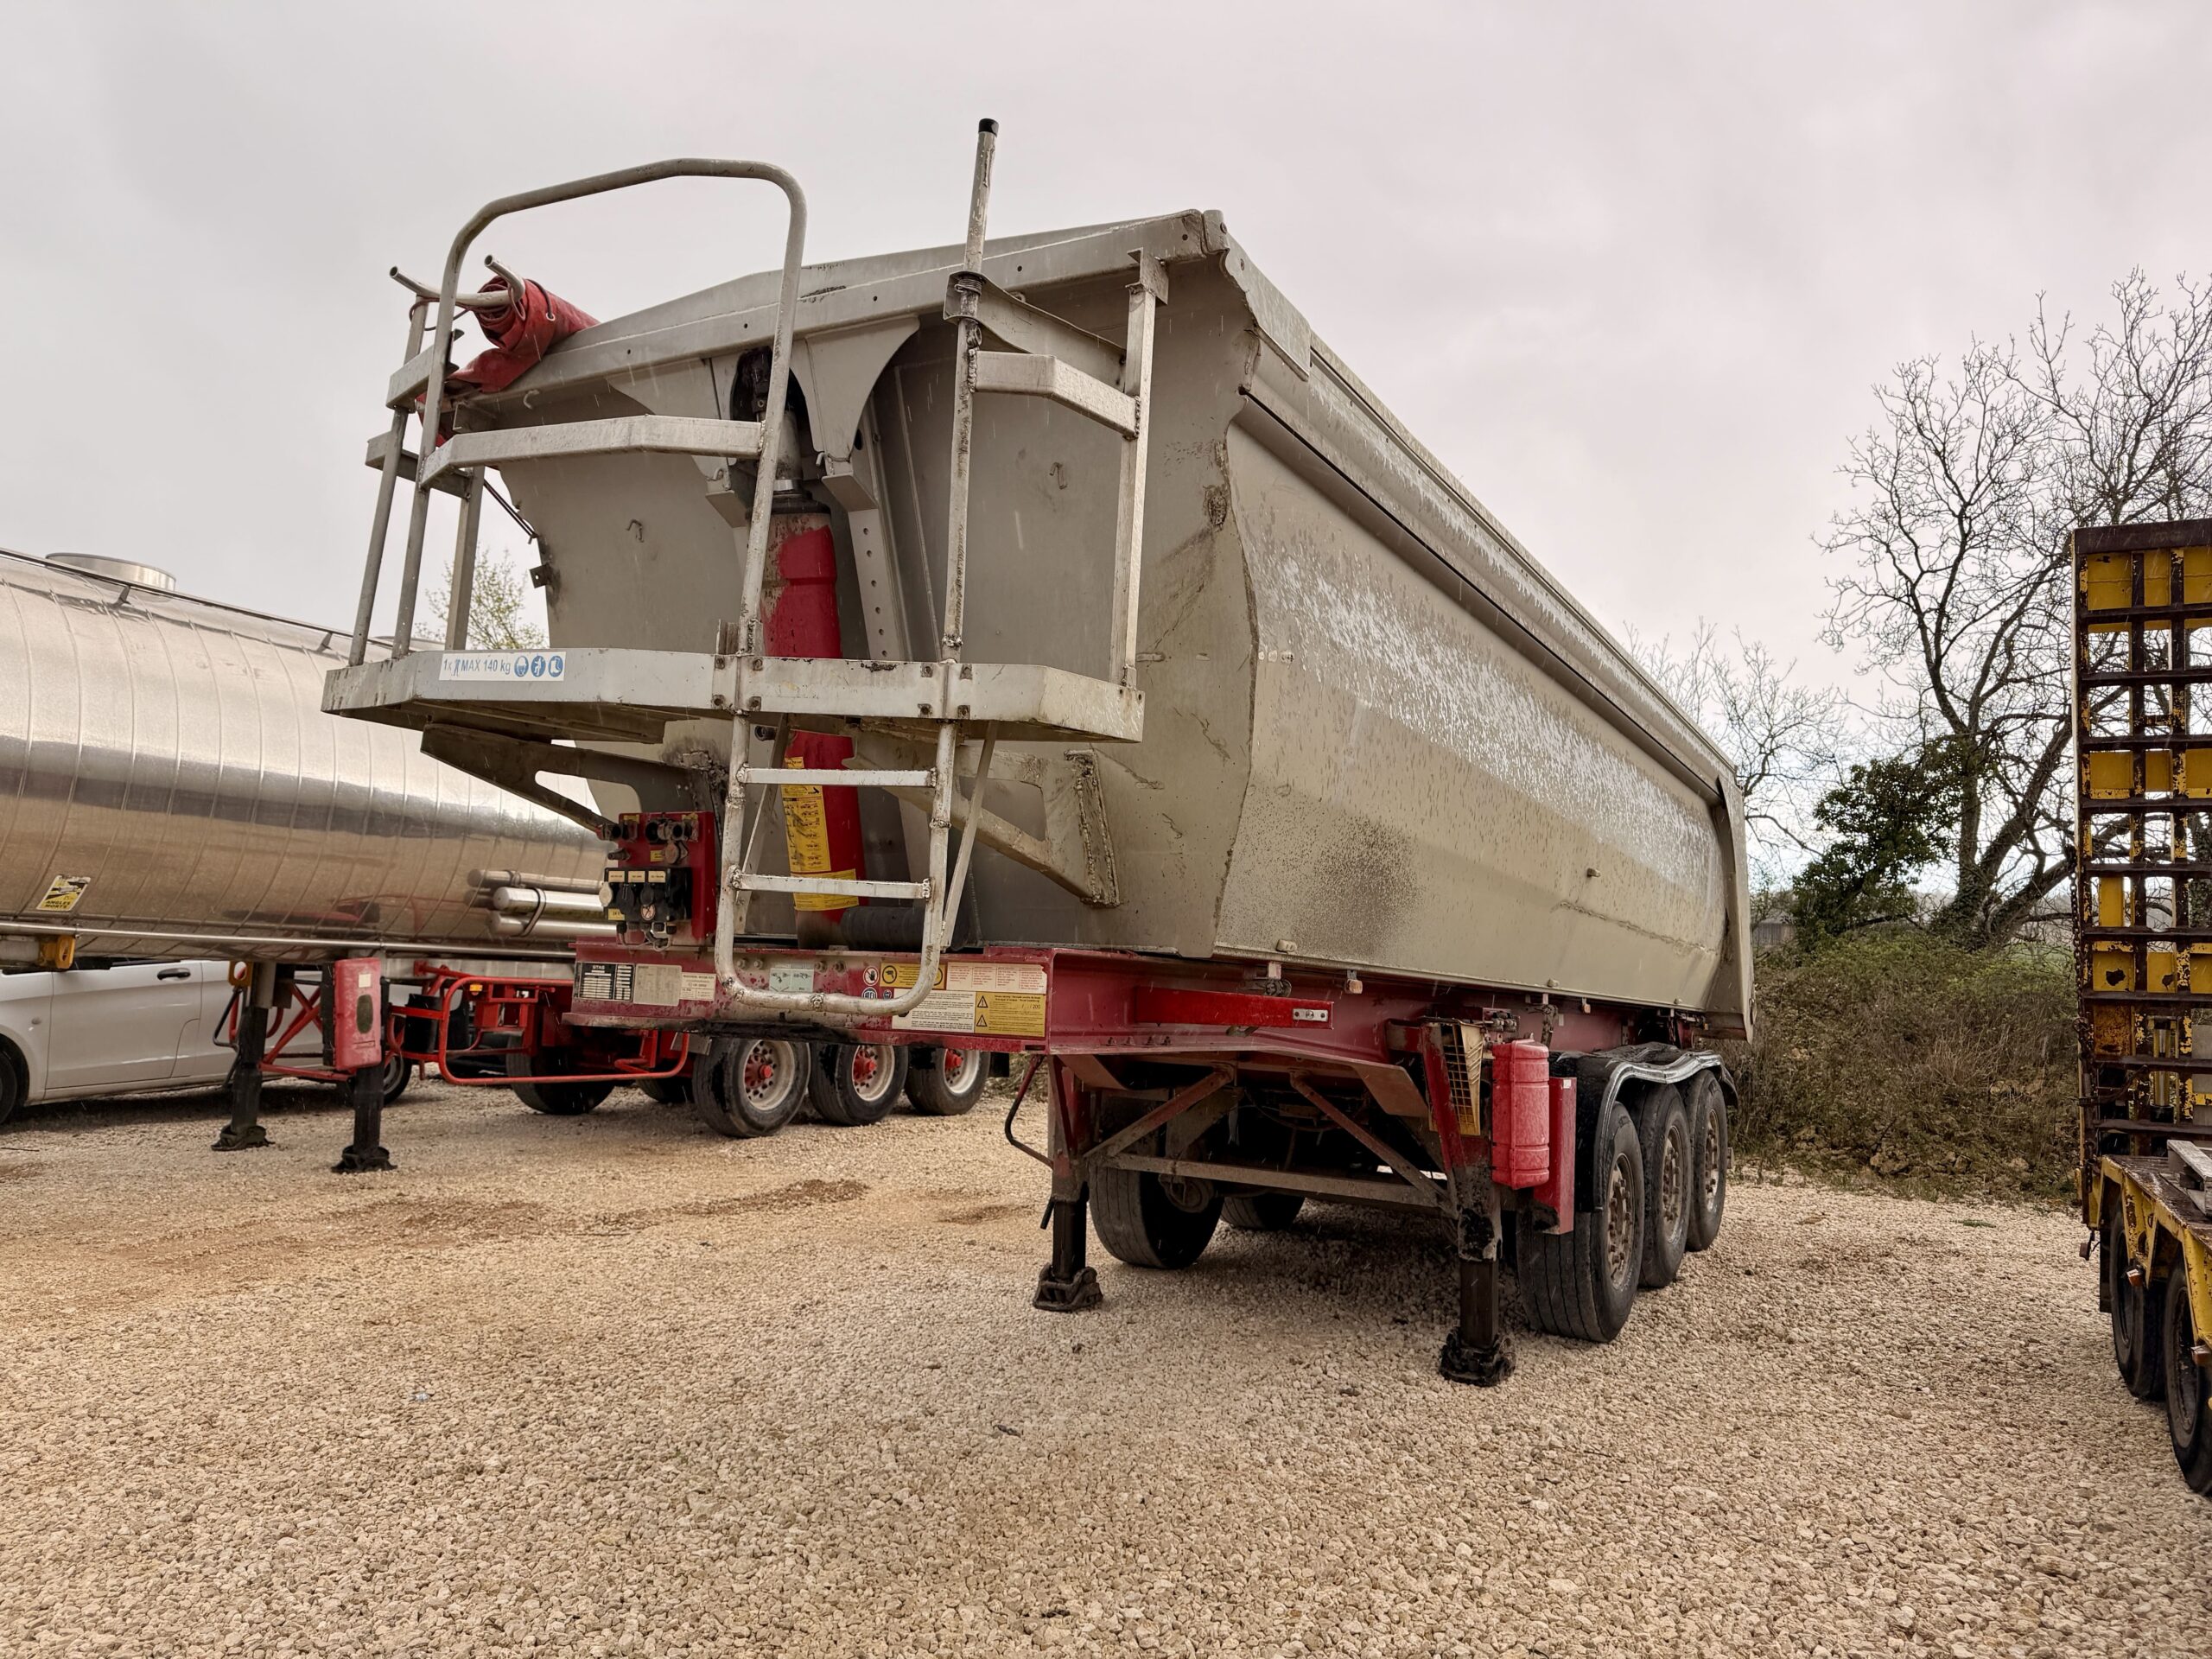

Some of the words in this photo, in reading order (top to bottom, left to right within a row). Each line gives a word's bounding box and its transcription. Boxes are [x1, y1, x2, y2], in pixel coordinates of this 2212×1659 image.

[461, 659, 480, 671] MAX
[484, 659, 499, 671] 140
[500, 659, 511, 675] kg
